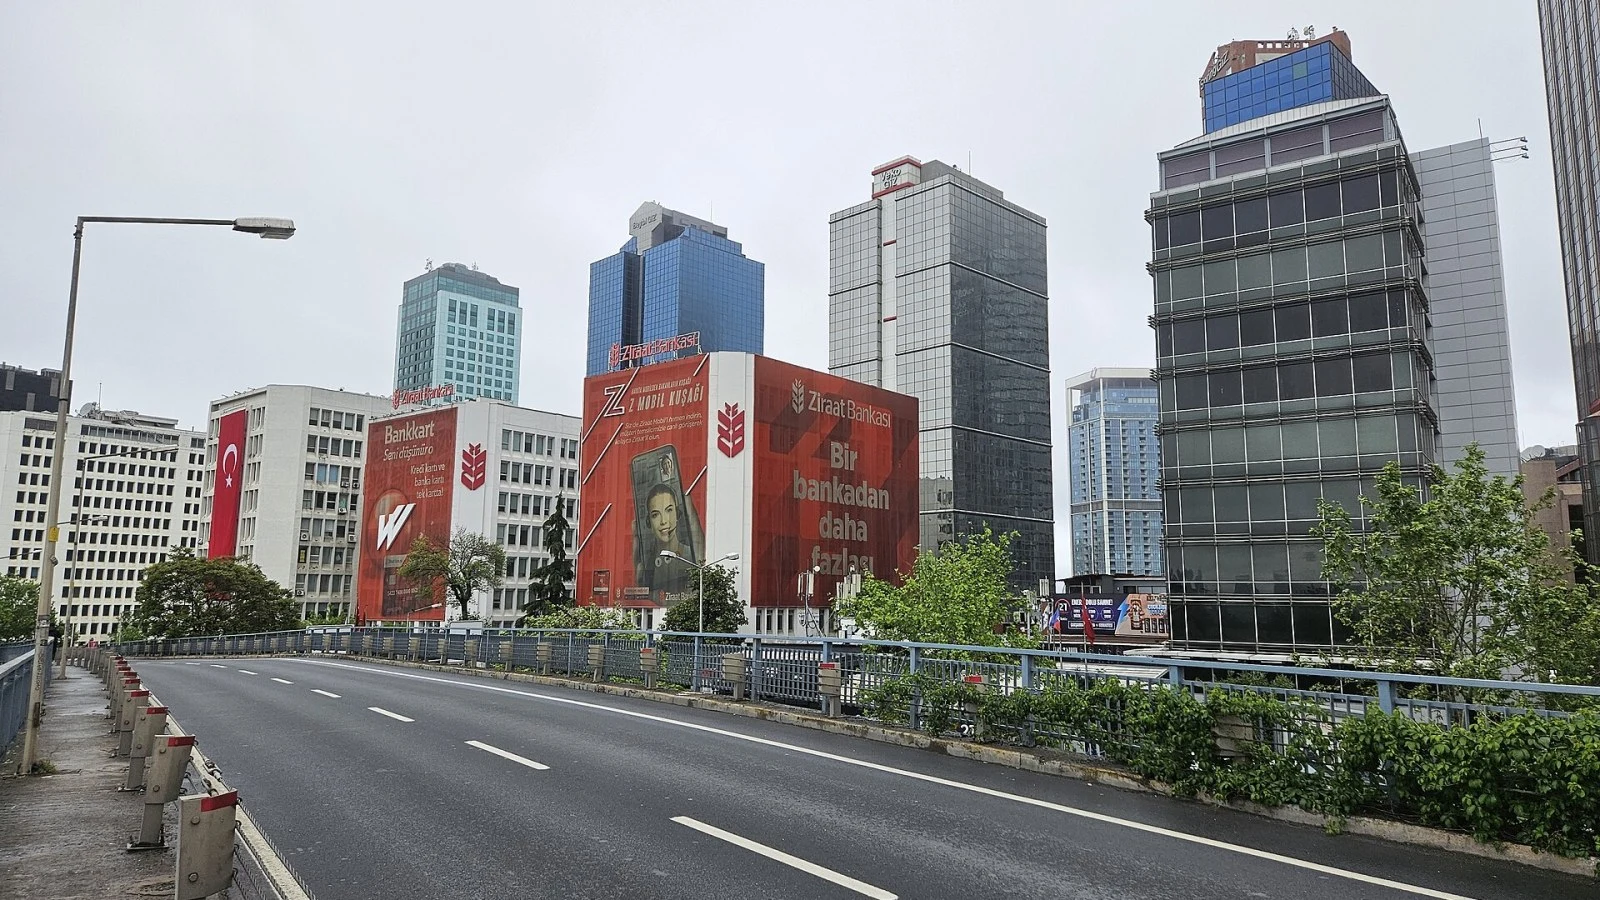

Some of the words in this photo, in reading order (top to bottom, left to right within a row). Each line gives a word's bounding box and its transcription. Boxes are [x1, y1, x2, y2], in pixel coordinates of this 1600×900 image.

[622, 346, 652, 361] Ziraat
[637, 393, 665, 411] MOBİL
[669, 383, 704, 407] KUŞAĞI
[808, 390, 845, 418] Ziraat
[847, 400, 891, 428] Bankası
[385, 420, 435, 445] Bankkart
[383, 447, 399, 461] Seni
[438, 463, 445, 471] ve
[830, 441, 857, 471] Bir
[793, 470, 890, 510] bankadan
[819, 511, 868, 542] daha
[811, 545, 874, 576] fazlası
[665, 592, 680, 601] Ziraat
